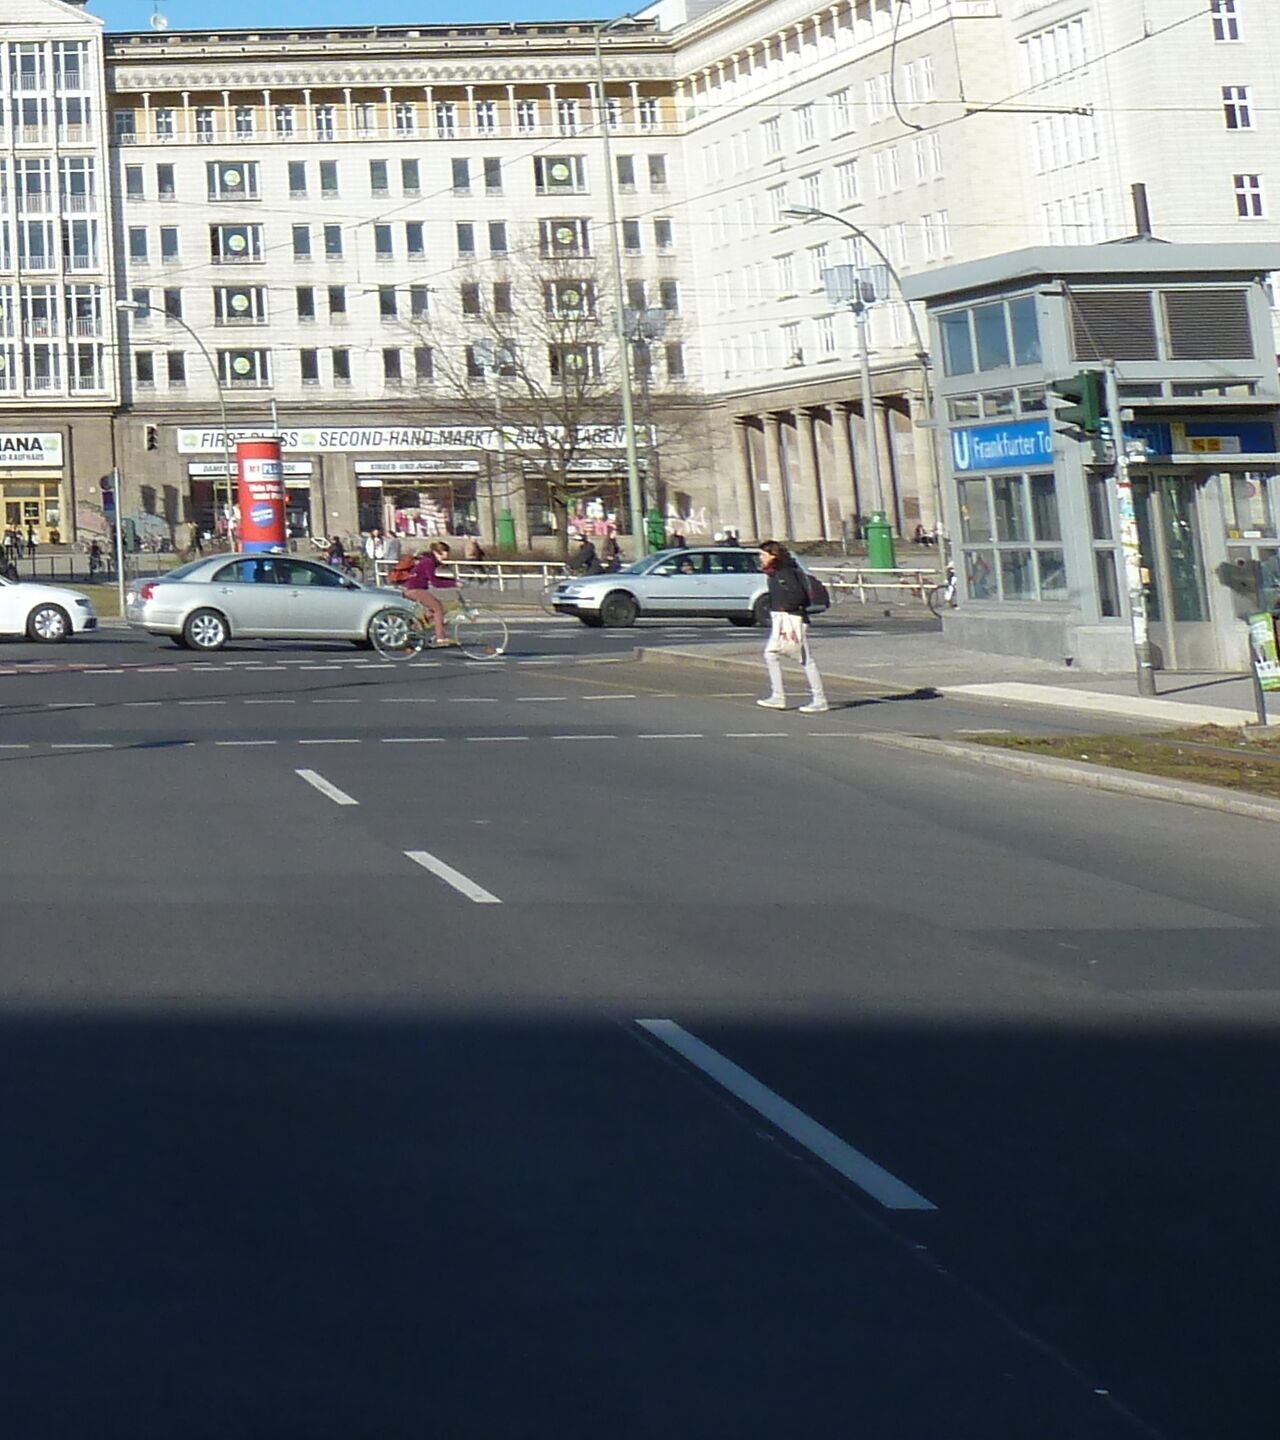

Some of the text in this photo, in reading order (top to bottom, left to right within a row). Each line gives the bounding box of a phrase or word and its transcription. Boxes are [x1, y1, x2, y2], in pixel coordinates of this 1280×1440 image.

[953, 431, 969, 469] U
[974, 430, 1053, 459] Frankfurter To
